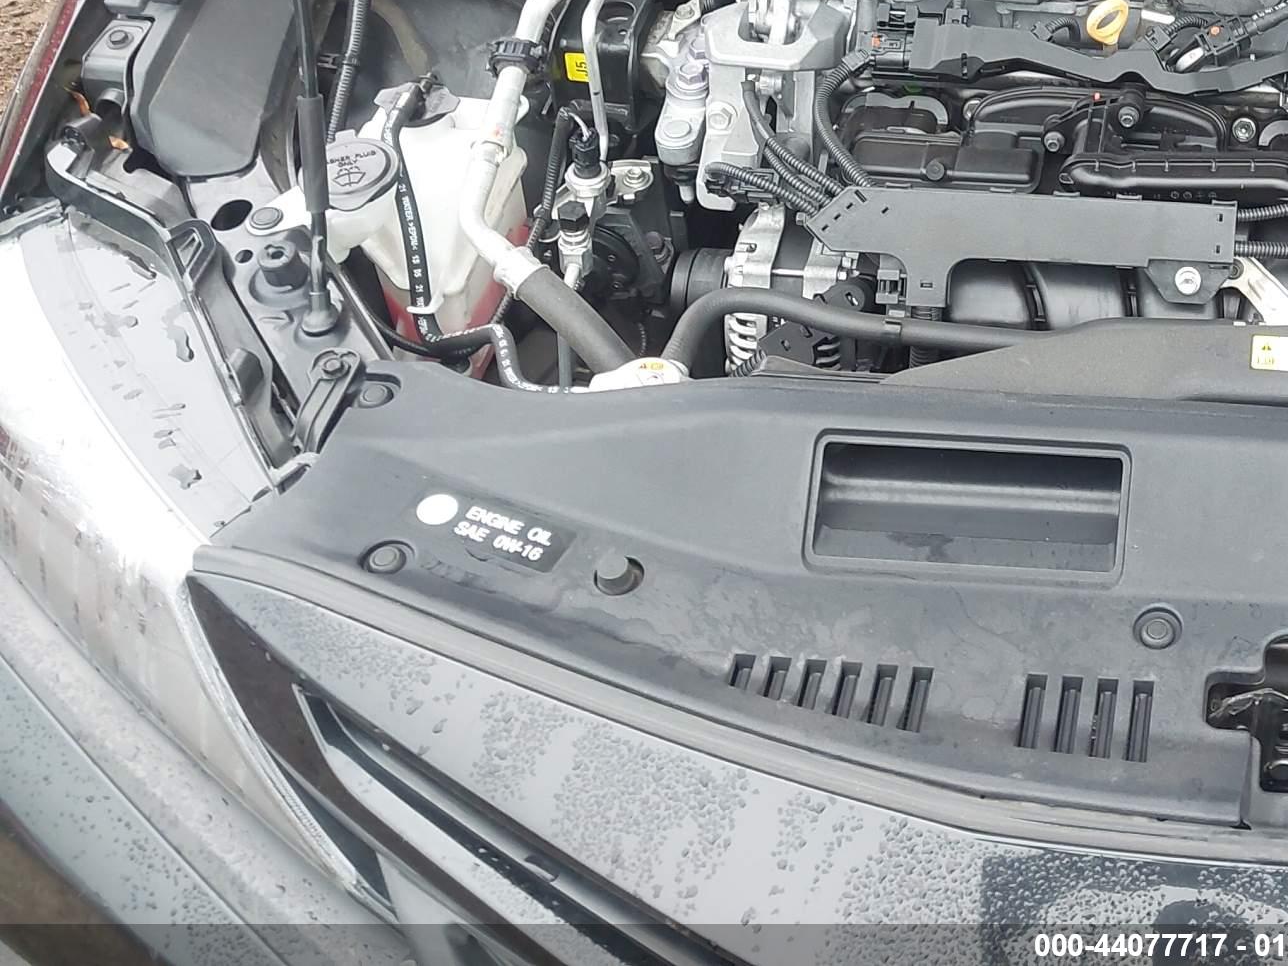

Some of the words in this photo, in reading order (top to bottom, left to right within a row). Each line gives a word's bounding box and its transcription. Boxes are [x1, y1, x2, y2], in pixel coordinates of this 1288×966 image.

[338, 158, 357, 168] ONLY
[355, 149, 376, 159] FLUID
[465, 505, 525, 536] ENGINE
[527, 527, 552, 547] OIL
[454, 521, 491, 542] SAE
[493, 535, 544, 561] 0W-16
